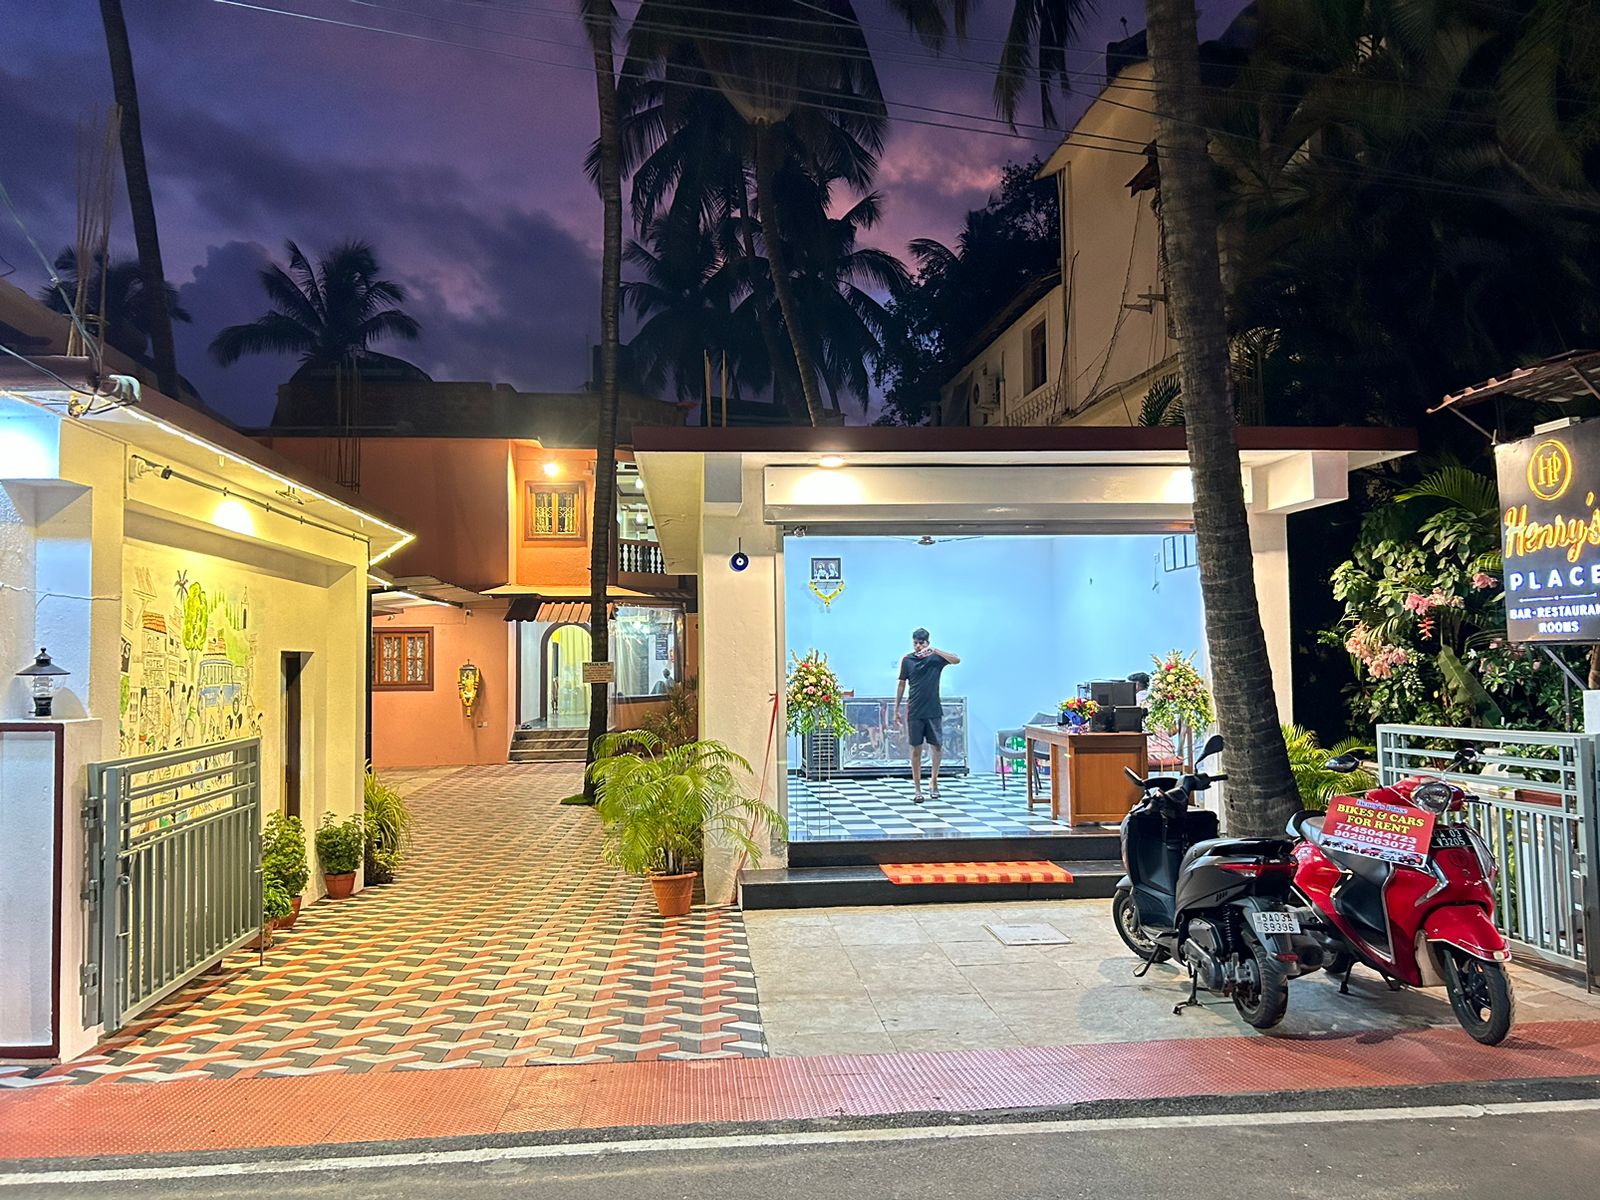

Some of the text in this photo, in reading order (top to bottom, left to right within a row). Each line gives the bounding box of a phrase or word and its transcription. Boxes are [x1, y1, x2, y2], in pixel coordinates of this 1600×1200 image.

[1504, 491, 1600, 563] Henry's
[1509, 564, 1600, 591] PLACE
[1538, 620, 1581, 633] ROOMS
[1337, 803, 1425, 828] BIKES & CARS
[1346, 814, 1410, 834] FOR RENT
[1333, 829, 1416, 852] 9028063072
[1336, 822, 1417, 844] 7745044723
